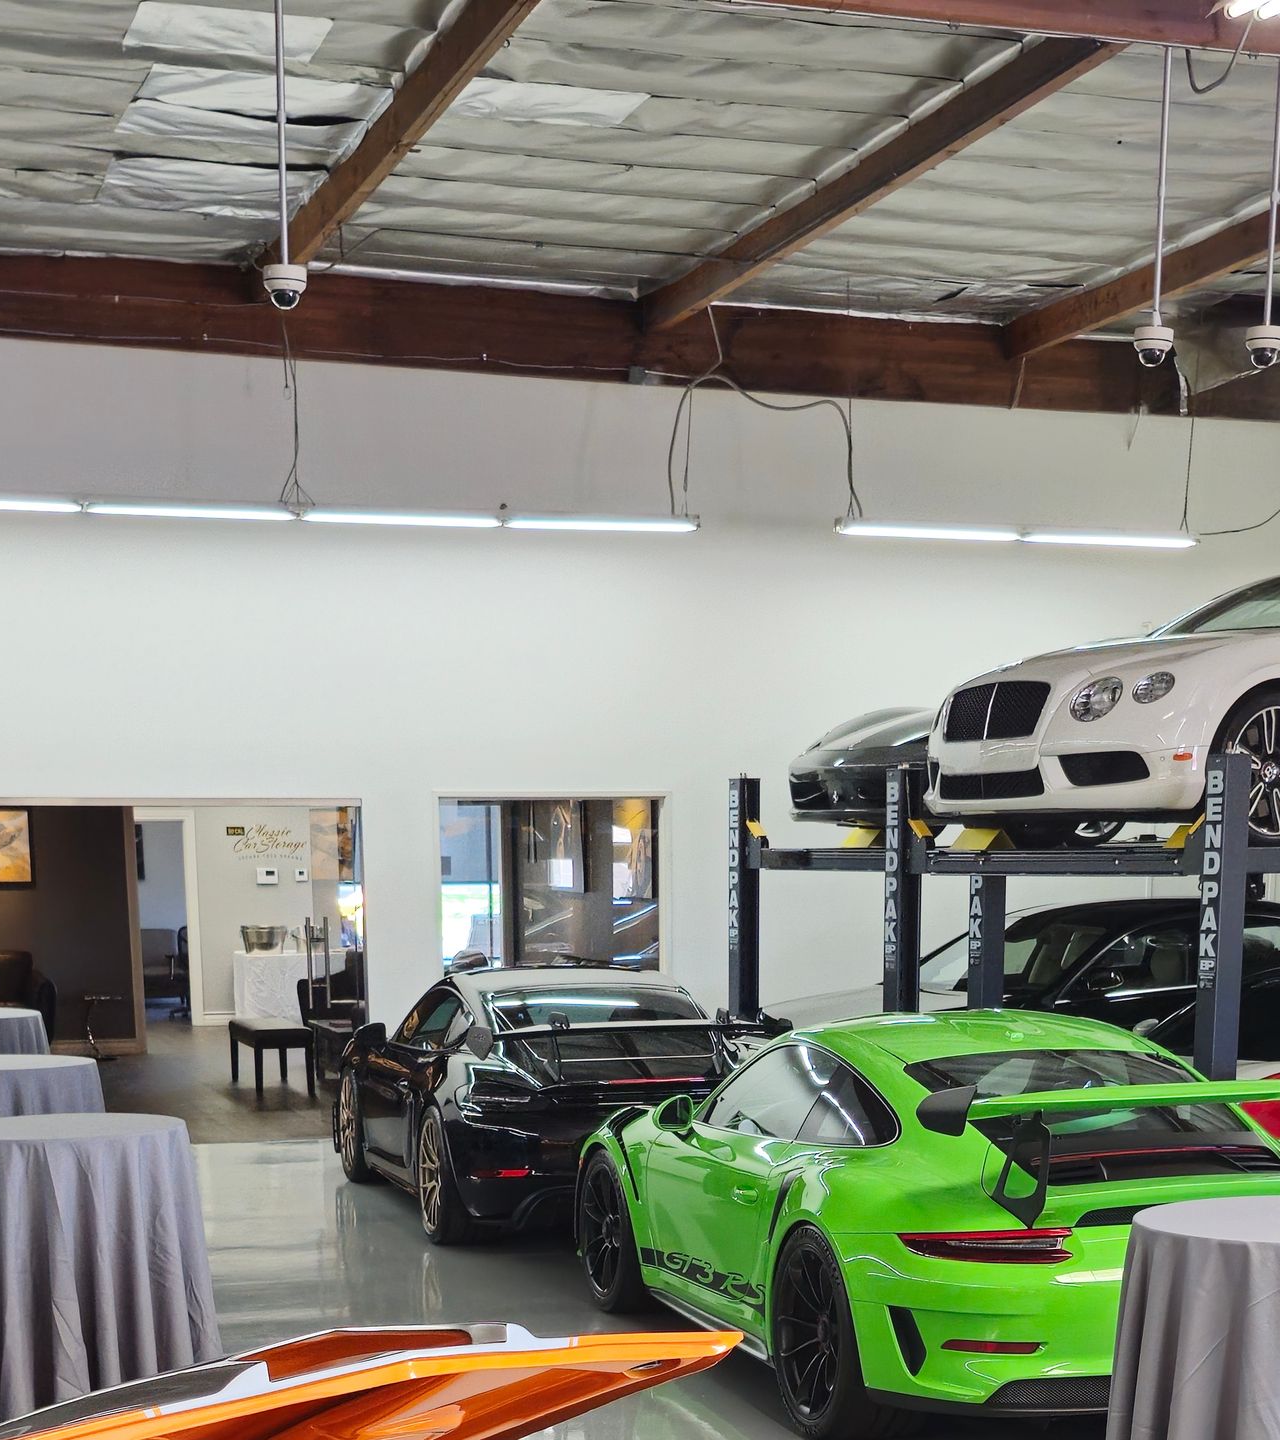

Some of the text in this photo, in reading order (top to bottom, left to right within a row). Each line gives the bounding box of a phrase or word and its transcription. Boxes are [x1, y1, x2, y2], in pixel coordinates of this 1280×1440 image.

[729, 790, 740, 927] BENDPAK
[885, 782, 900, 942] BENDPAK
[1199, 770, 1224, 957] BENDPAK
[664, 1252, 766, 1305] GT3 RS
